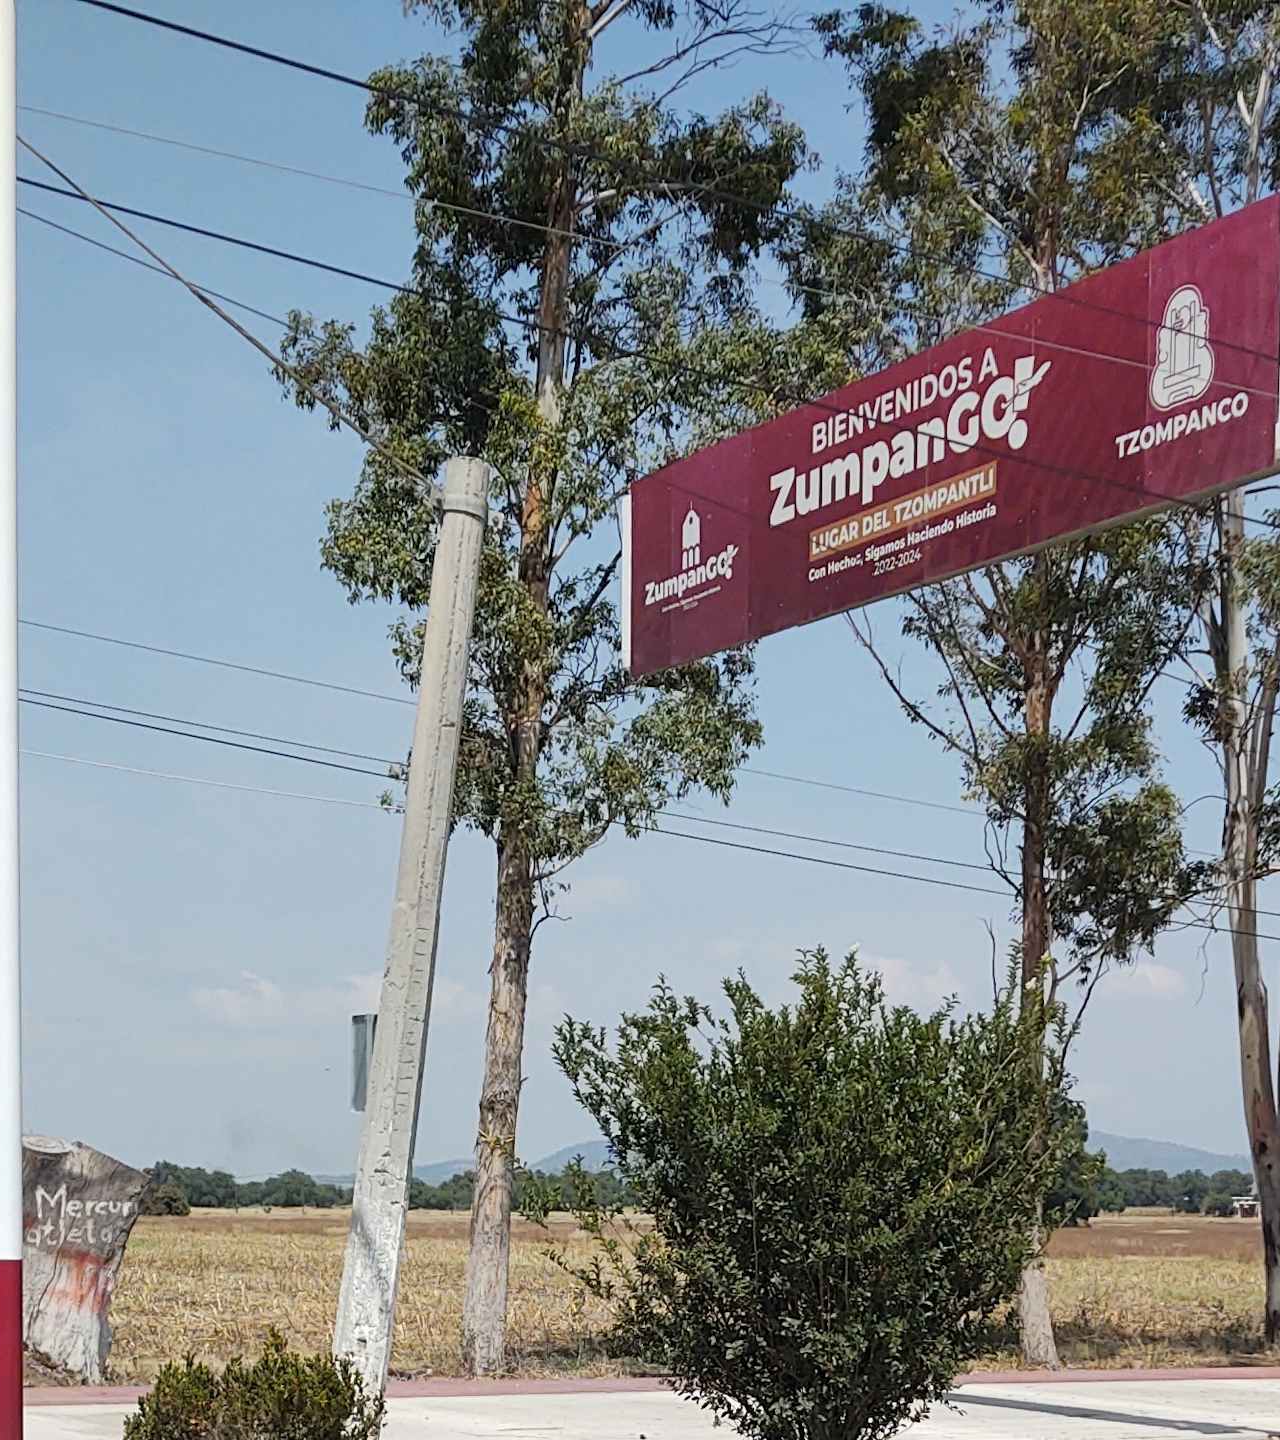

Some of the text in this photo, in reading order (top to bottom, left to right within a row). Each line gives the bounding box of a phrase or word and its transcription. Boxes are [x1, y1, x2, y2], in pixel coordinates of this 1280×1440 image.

[811, 347, 999, 454] BIENVENIDOS A
[1115, 391, 1249, 459] TZOMPANCO
[808, 502, 997, 583] Con Hechos, Sigamos Haciendo Historia
[811, 467, 995, 556] LUGAR DEL TZOMPANTLI
[873, 547, 923, 577] 2022-2024
